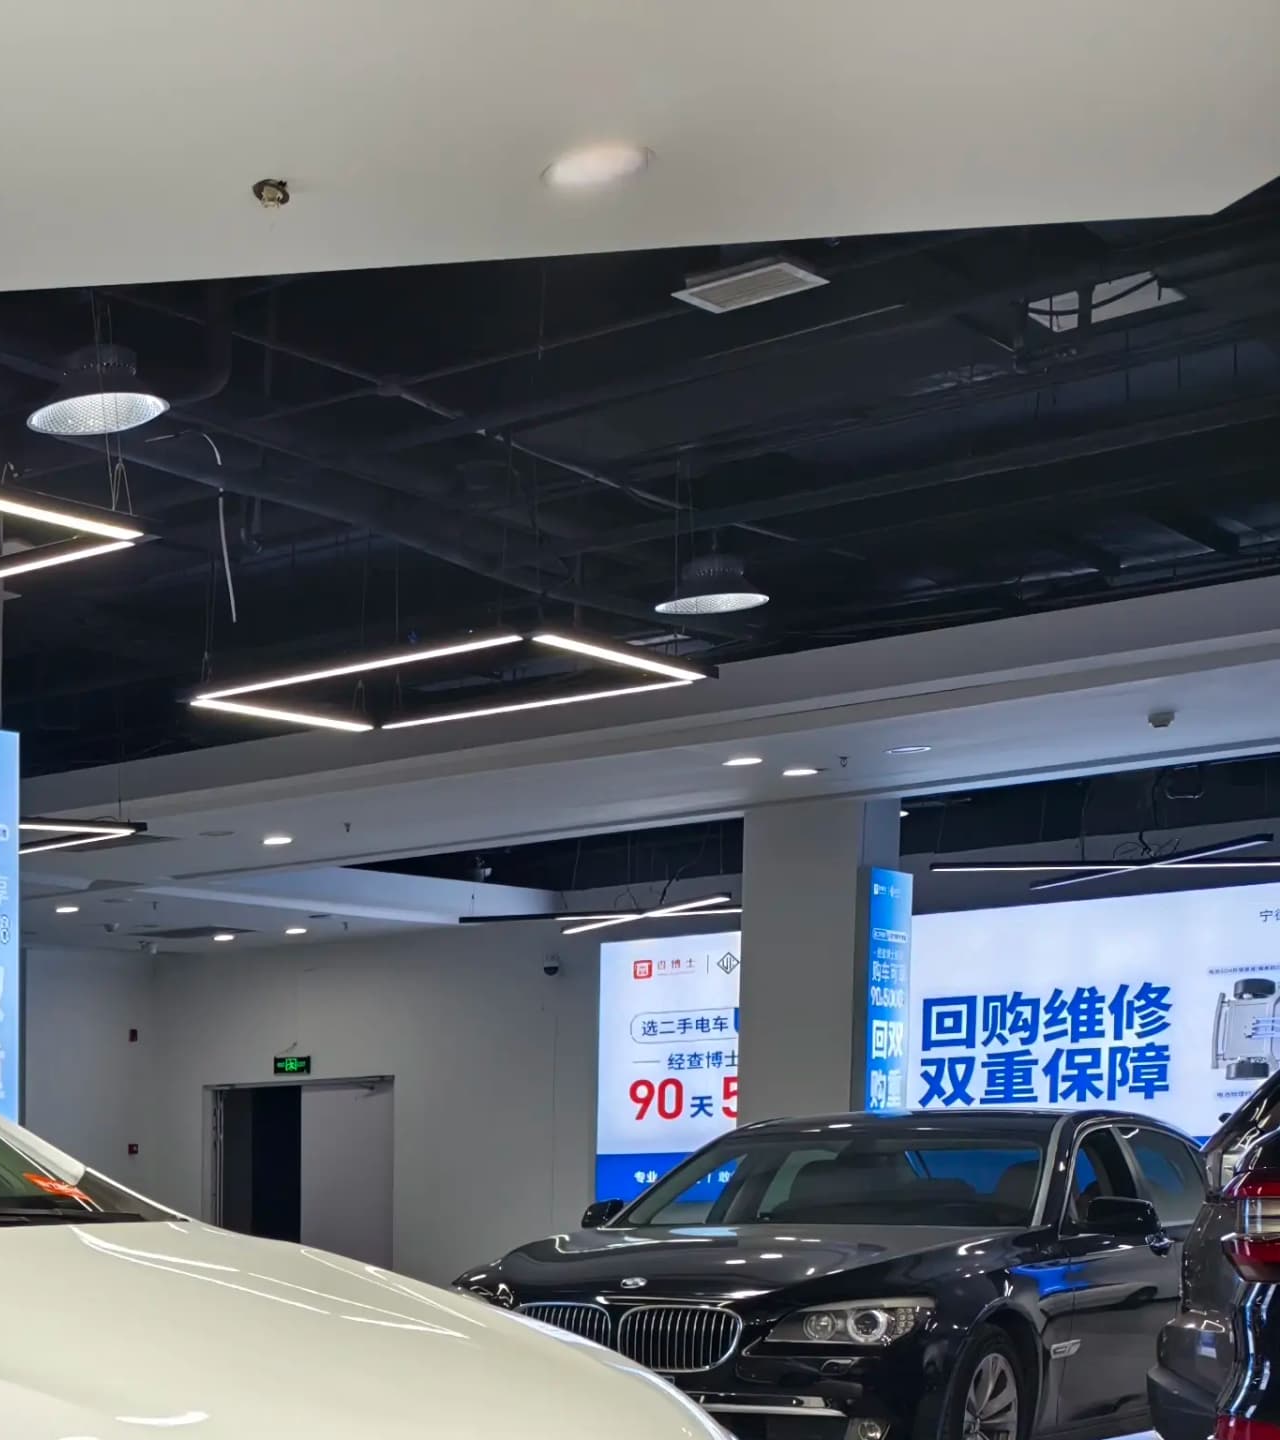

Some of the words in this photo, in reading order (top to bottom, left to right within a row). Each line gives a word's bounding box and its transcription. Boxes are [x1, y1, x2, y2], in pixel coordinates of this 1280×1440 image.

[642, 1016, 729, 1036] 选二手电车
[921, 982, 1173, 1051] 回购维修
[667, 1050, 738, 1070] 经查博士
[918, 1042, 1171, 1108] 双重保障
